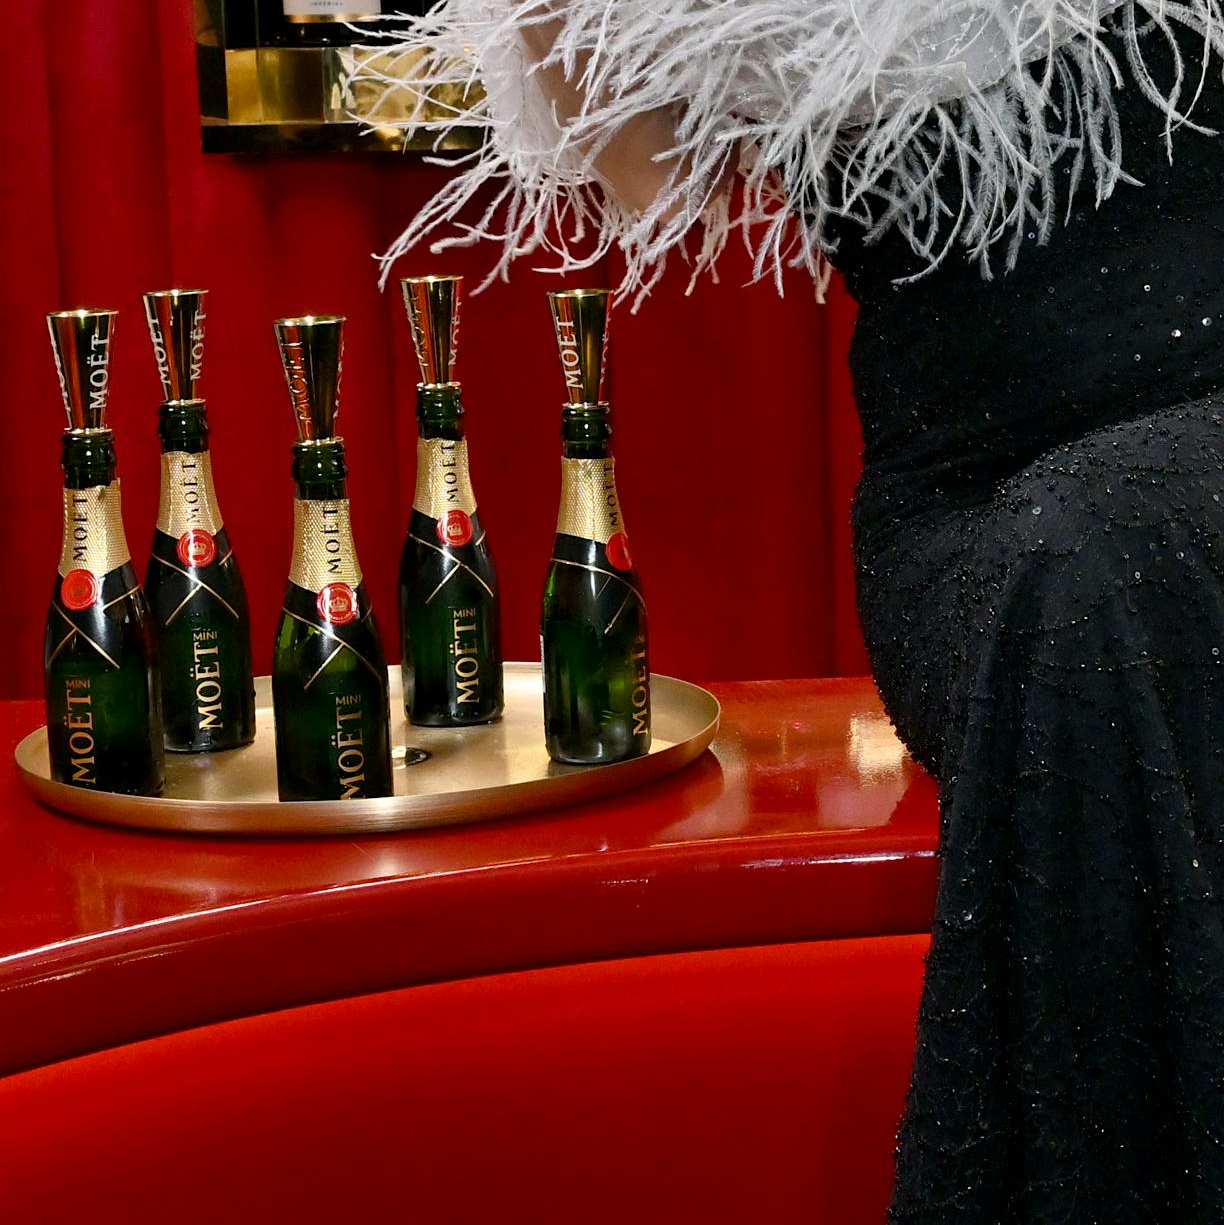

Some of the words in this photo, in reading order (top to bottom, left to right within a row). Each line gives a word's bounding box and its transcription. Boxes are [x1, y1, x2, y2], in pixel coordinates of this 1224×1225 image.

[86, 335, 110, 409] MOËT
[192, 631, 218, 642] MINI
[453, 607, 477, 618] MINI
[65, 679, 91, 689] MINI
[189, 642, 223, 730] MOËT
[449, 618, 480, 704] MOËT
[63, 689, 97, 785] MOËT
[335, 694, 362, 706] MINI
[331, 706, 365, 800] MOËT
